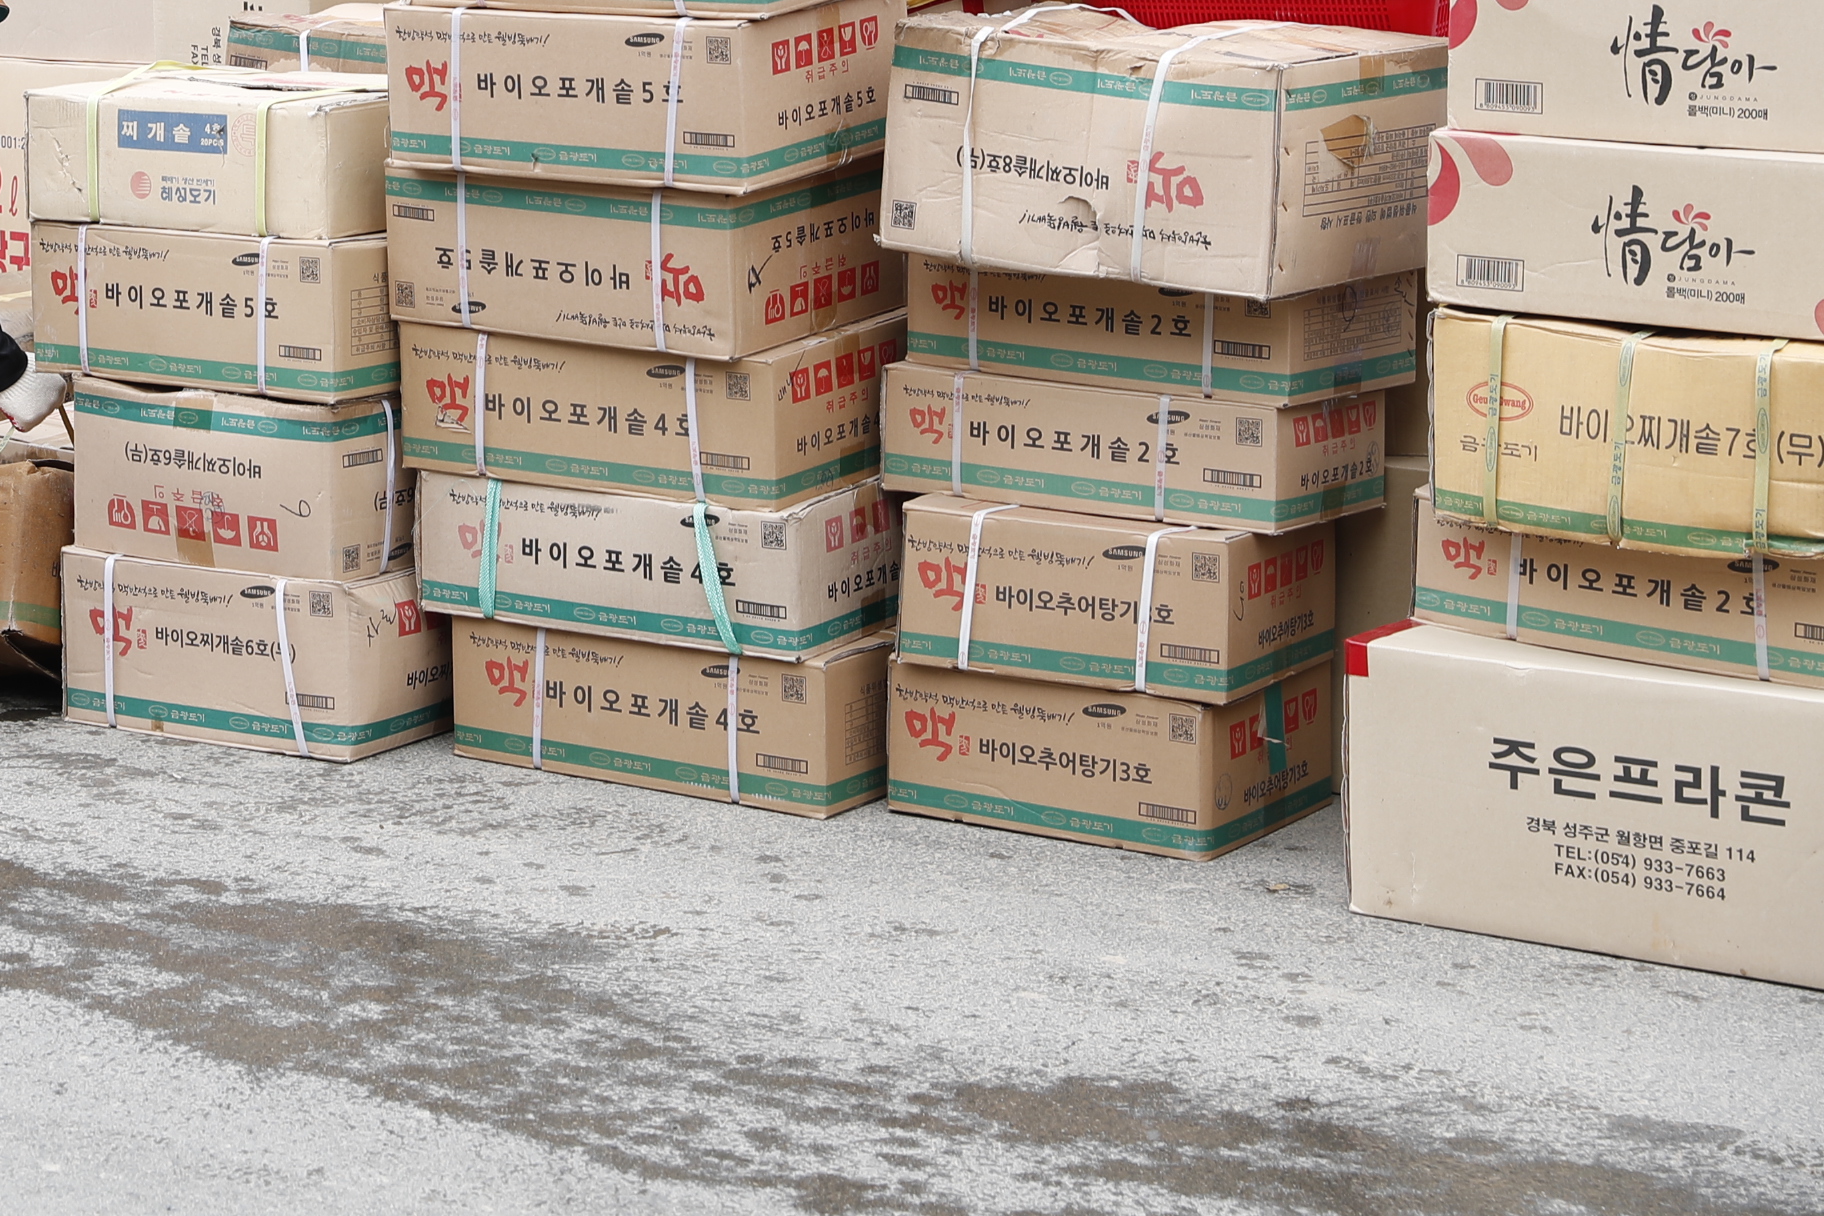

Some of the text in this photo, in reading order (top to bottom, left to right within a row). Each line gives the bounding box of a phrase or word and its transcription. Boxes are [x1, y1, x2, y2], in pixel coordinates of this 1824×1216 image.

[629, 35, 661, 46] SAMSUNG
[405, 58, 448, 112] 맥
[476, 71, 684, 106] 바이오포개솥5호
[805, 59, 849, 83] 취급주의
[777, 85, 876, 131] 바이오포개솥5호
[1699, 93, 1759, 103] JUNGDAMA
[1736, 105, 1769, 122] 200매
[121, 120, 191, 144] 찌개솥
[558, 150, 597, 163] 금광도기
[771, 212, 875, 254] 바이오포개솥5호
[1678, 274, 1737, 287] JUNGDAMA
[1714, 289, 1746, 306] 200매
[105, 281, 280, 321] 바이오포개솥5호
[931, 280, 967, 321] 맥
[988, 294, 1192, 339] 바이오포개솥2호
[1077, 358, 1118, 372] 금광도기
[825, 387, 870, 413] 취급주의
[1472, 393, 1527, 411] Geuwang
[125, 441, 262, 479] 바이오찌개솥6호(무)
[969, 420, 1180, 466] 바이오포개솥2호
[570, 463, 609, 478] 금광도기
[1197, 498, 1241, 513] 금광도기
[1526, 511, 1572, 527] 금광도기
[1442, 536, 1486, 581] 맥
[598, 611, 637, 625] 금광도기
[1258, 610, 1314, 648] 바이오추어탕기3호
[1444, 599, 1604, 635] 금광도기 금광도기
[485, 656, 530, 708] 맥
[546, 678, 760, 735] 바이오포개솥4호
[1088, 705, 1121, 717] SAMSUNG
[904, 706, 956, 762] 맥
[979, 737, 1153, 786] 바이오추어탕기3호
[1488, 736, 1791, 827] 주은프라콘
[1526, 816, 1756, 863] 경북 성주군 월항면 중포길 114
[1554, 843, 1726, 882] TEL:(054) 933-7663
[1554, 862, 1726, 902] FAX:(054) 933-7664
